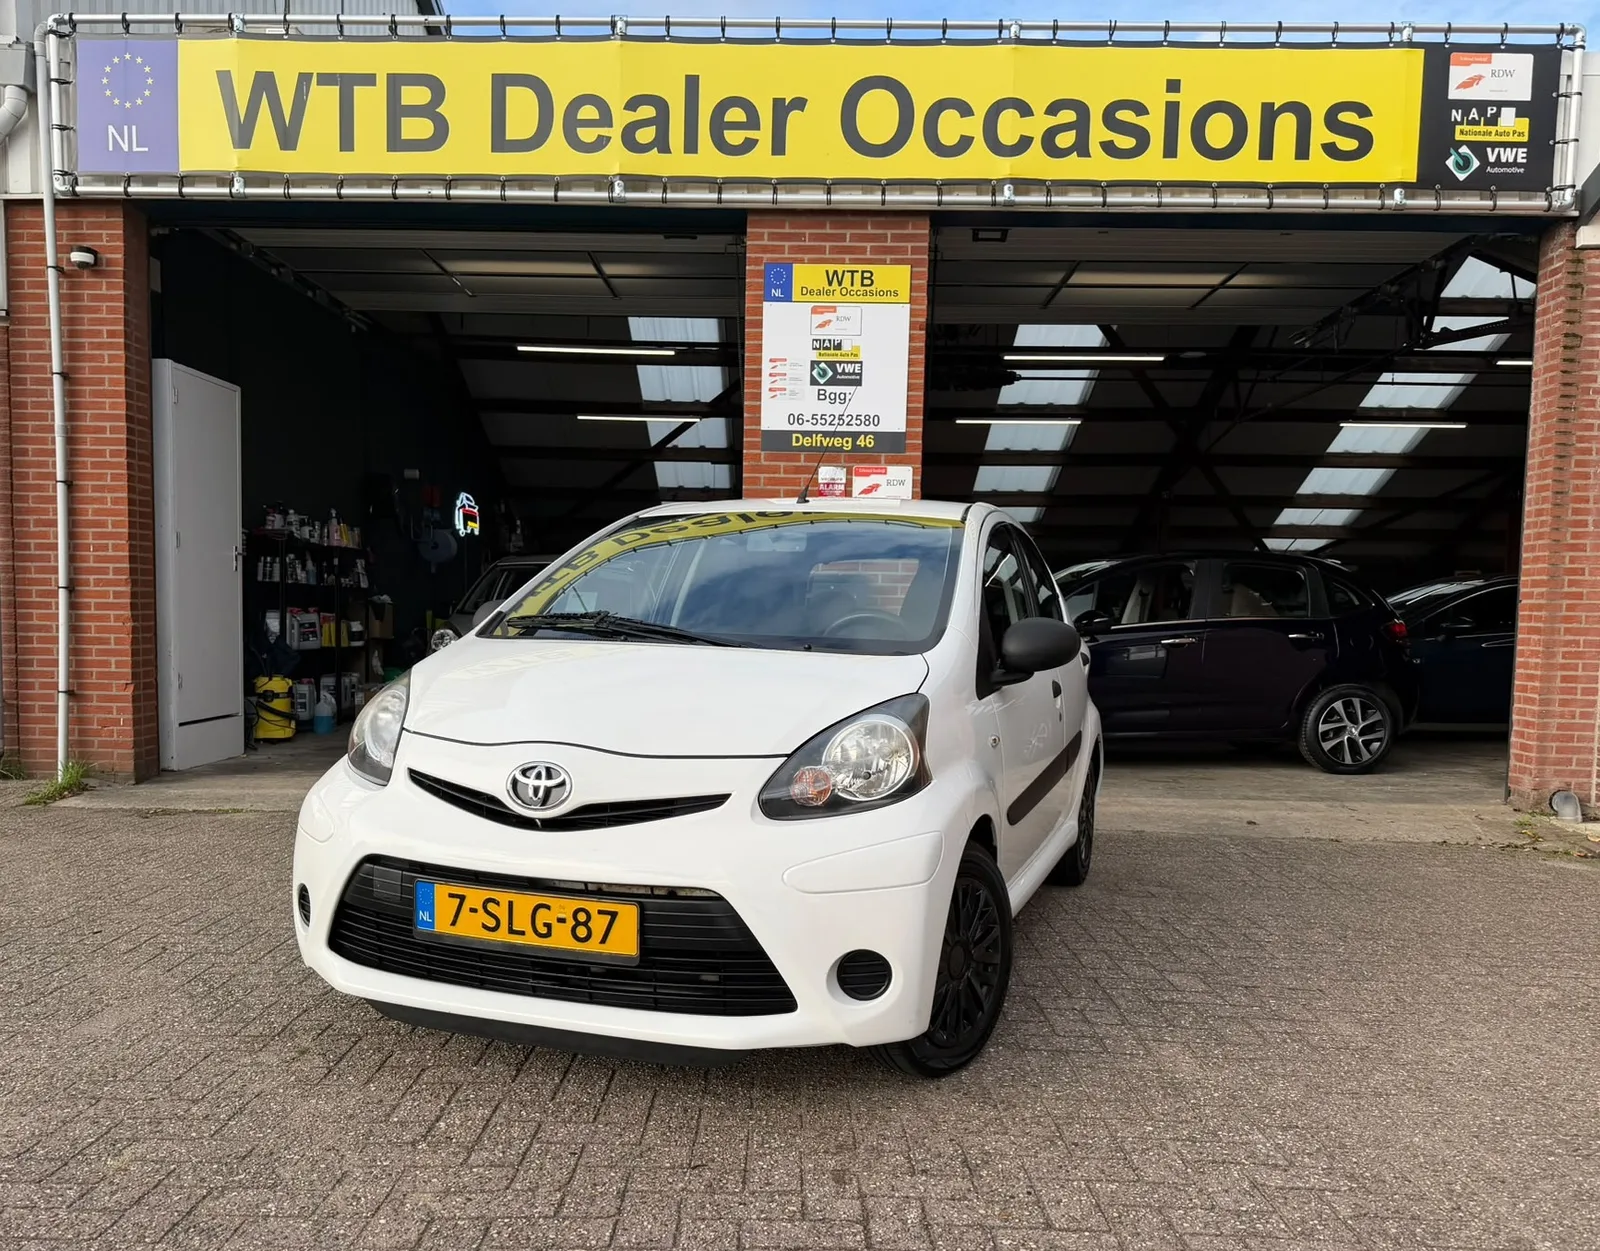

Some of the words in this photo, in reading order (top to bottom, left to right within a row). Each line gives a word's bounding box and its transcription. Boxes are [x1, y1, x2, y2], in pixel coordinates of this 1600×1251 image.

[1490, 69, 1516, 78] RDW
[216, 70, 450, 153] WTB
[490, 73, 809, 157] Dealer
[840, 75, 1374, 162] Occasions
[1451, 106, 1498, 122] NAP
[107, 124, 149, 153] NL
[1459, 128, 1493, 137] Nationale
[1494, 129, 1511, 138] Auto
[1512, 130, 1526, 138] Pas
[1486, 147, 1528, 163] VWE
[1486, 166, 1525, 174] Automotive
[825, 269, 875, 287] WTB
[771, 288, 784, 298] NL
[800, 286, 837, 297] Dealer
[839, 287, 899, 298] Occasions
[836, 363, 862, 374] VWE
[787, 412, 881, 428] 06-55252580
[791, 433, 852, 450] Delfweg
[856, 434, 875, 448] 46
[819, 483, 845, 491] ALARM
[886, 478, 906, 487] RDW
[419, 910, 433, 922] NL
[447, 892, 619, 945] 7-SLG-87
